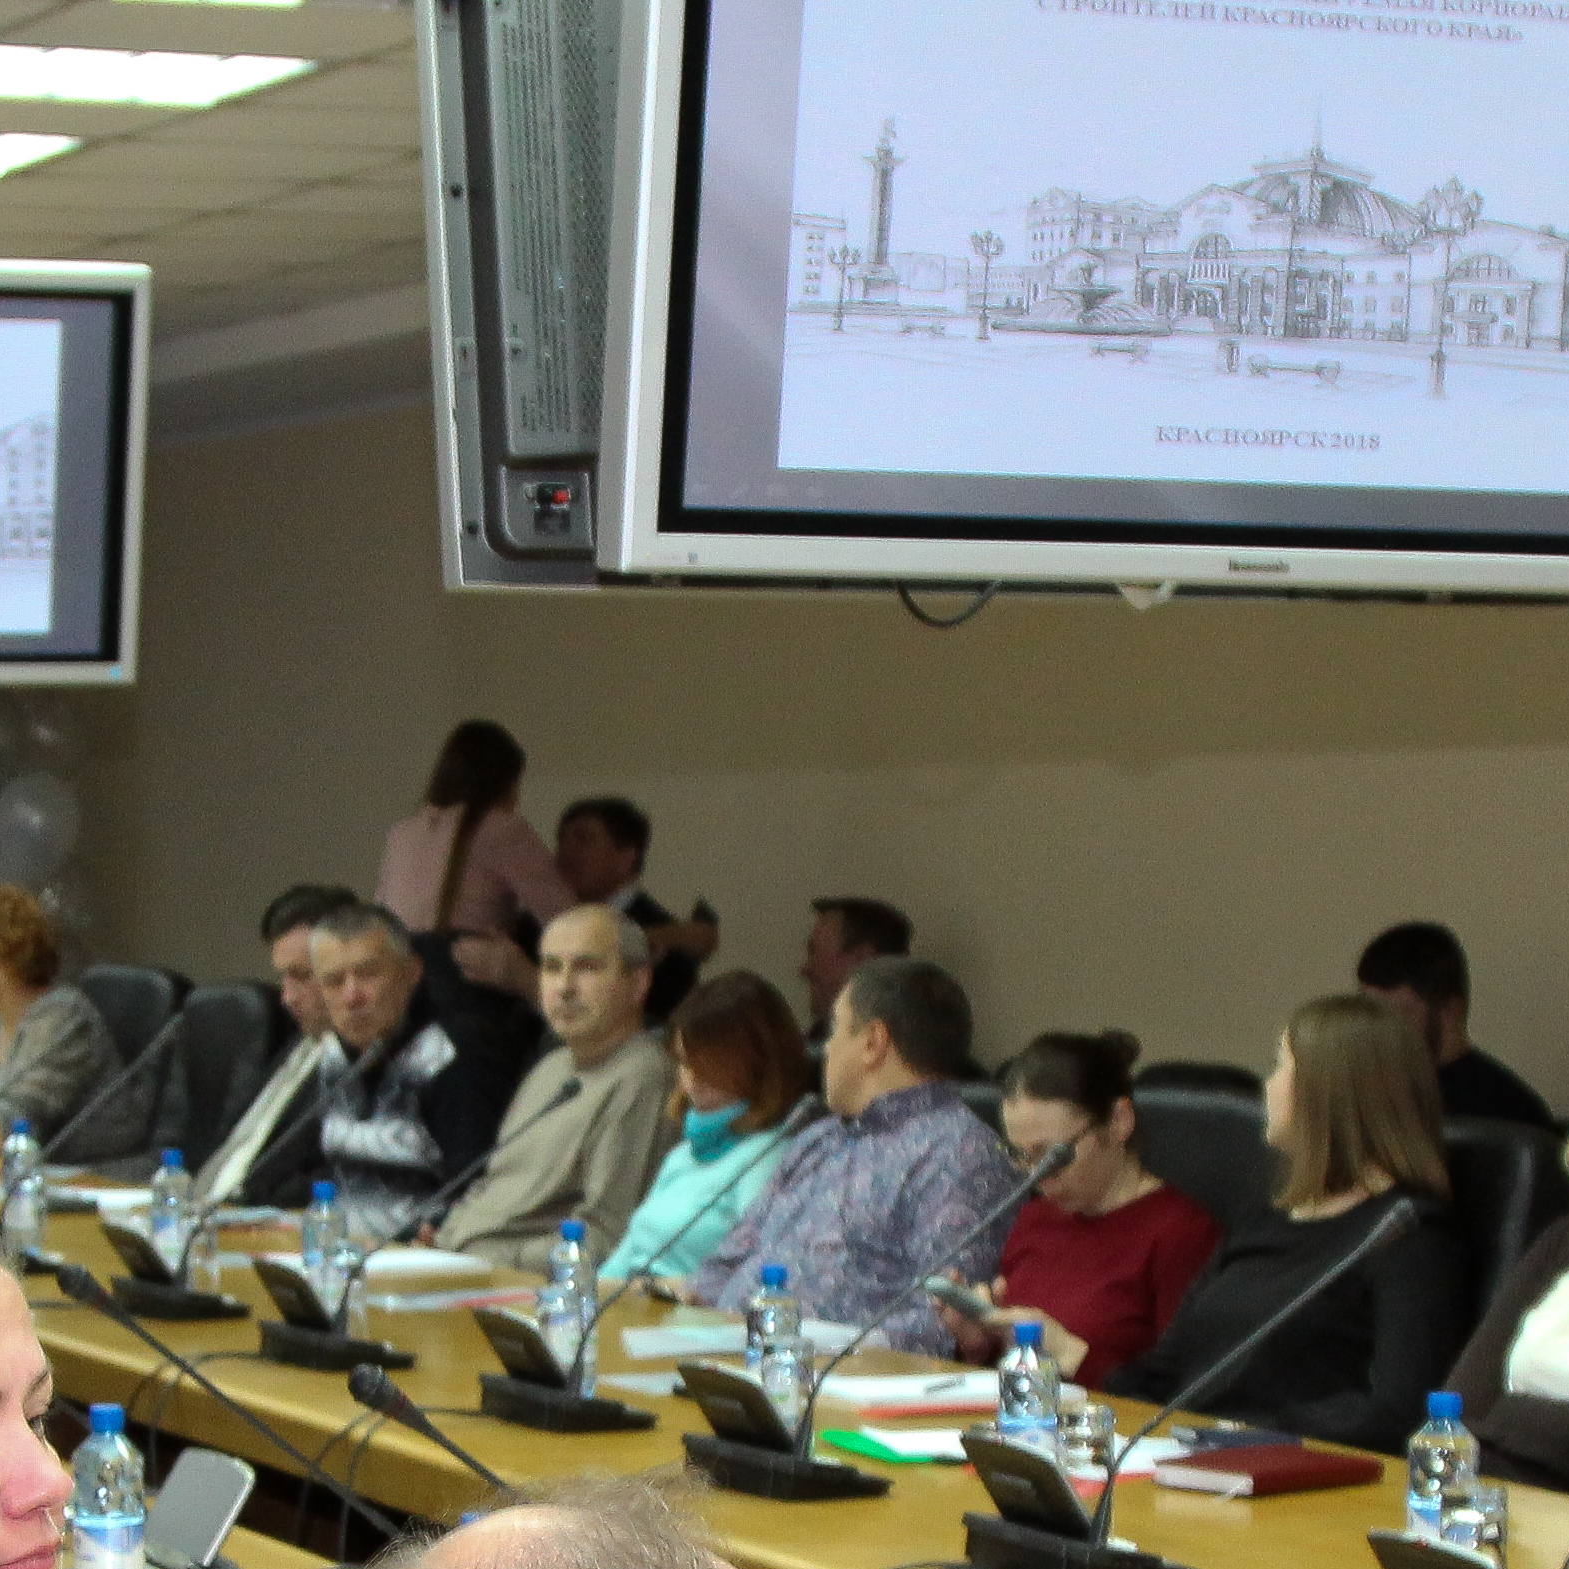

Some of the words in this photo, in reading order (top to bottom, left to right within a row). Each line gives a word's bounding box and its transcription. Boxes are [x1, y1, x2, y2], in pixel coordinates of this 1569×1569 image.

[1224, 6, 1443, 36] КРАСНОЯРСКОГО
[1155, 426, 1327, 449] КРАСНОЯРСК
[1330, 432, 1381, 450] 2018
